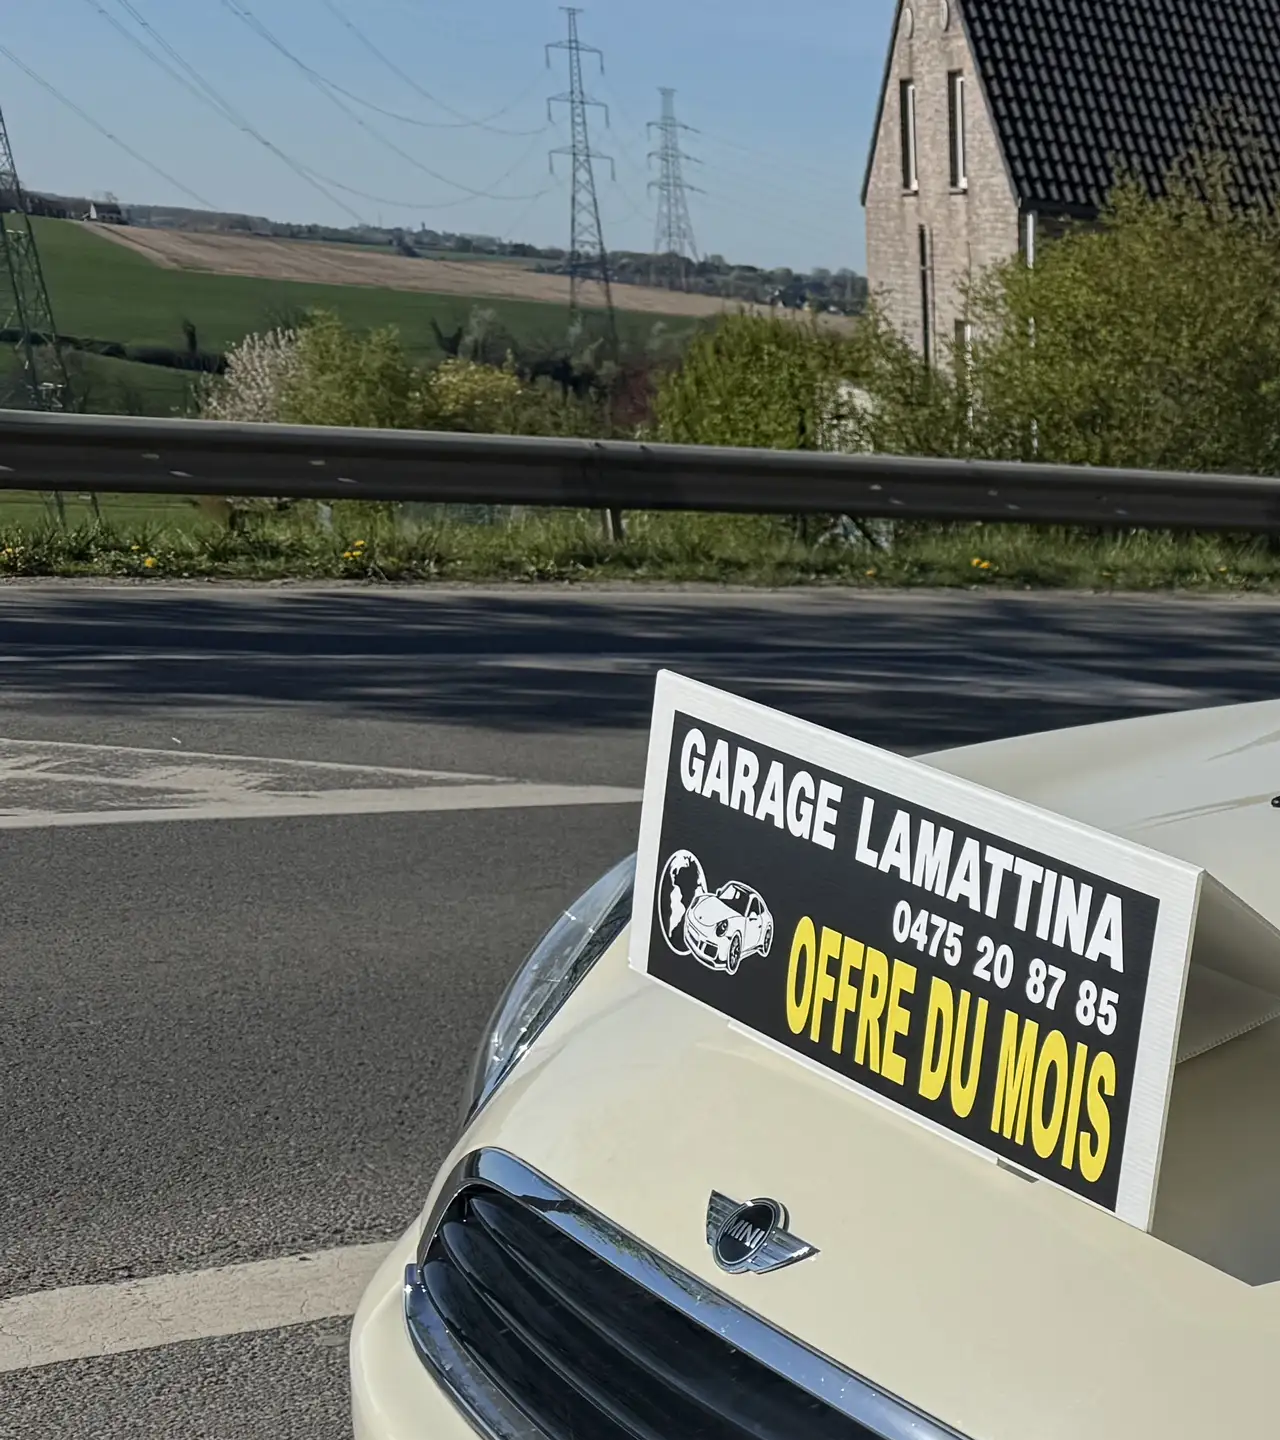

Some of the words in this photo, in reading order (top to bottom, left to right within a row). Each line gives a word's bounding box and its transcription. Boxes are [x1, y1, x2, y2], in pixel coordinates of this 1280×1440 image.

[680, 727, 843, 850] GARAGE
[855, 796, 1124, 973] LAMATTINA
[786, 915, 917, 1086] OFFRE
[919, 976, 988, 1119] DU
[991, 1012, 1116, 1183] MOIS
[892, 900, 963, 966] 0475
[973, 934, 1014, 989] 20
[1027, 962, 1066, 1010] 87
[1075, 986, 1120, 1036] 85
[724, 1216, 766, 1249] MINI
